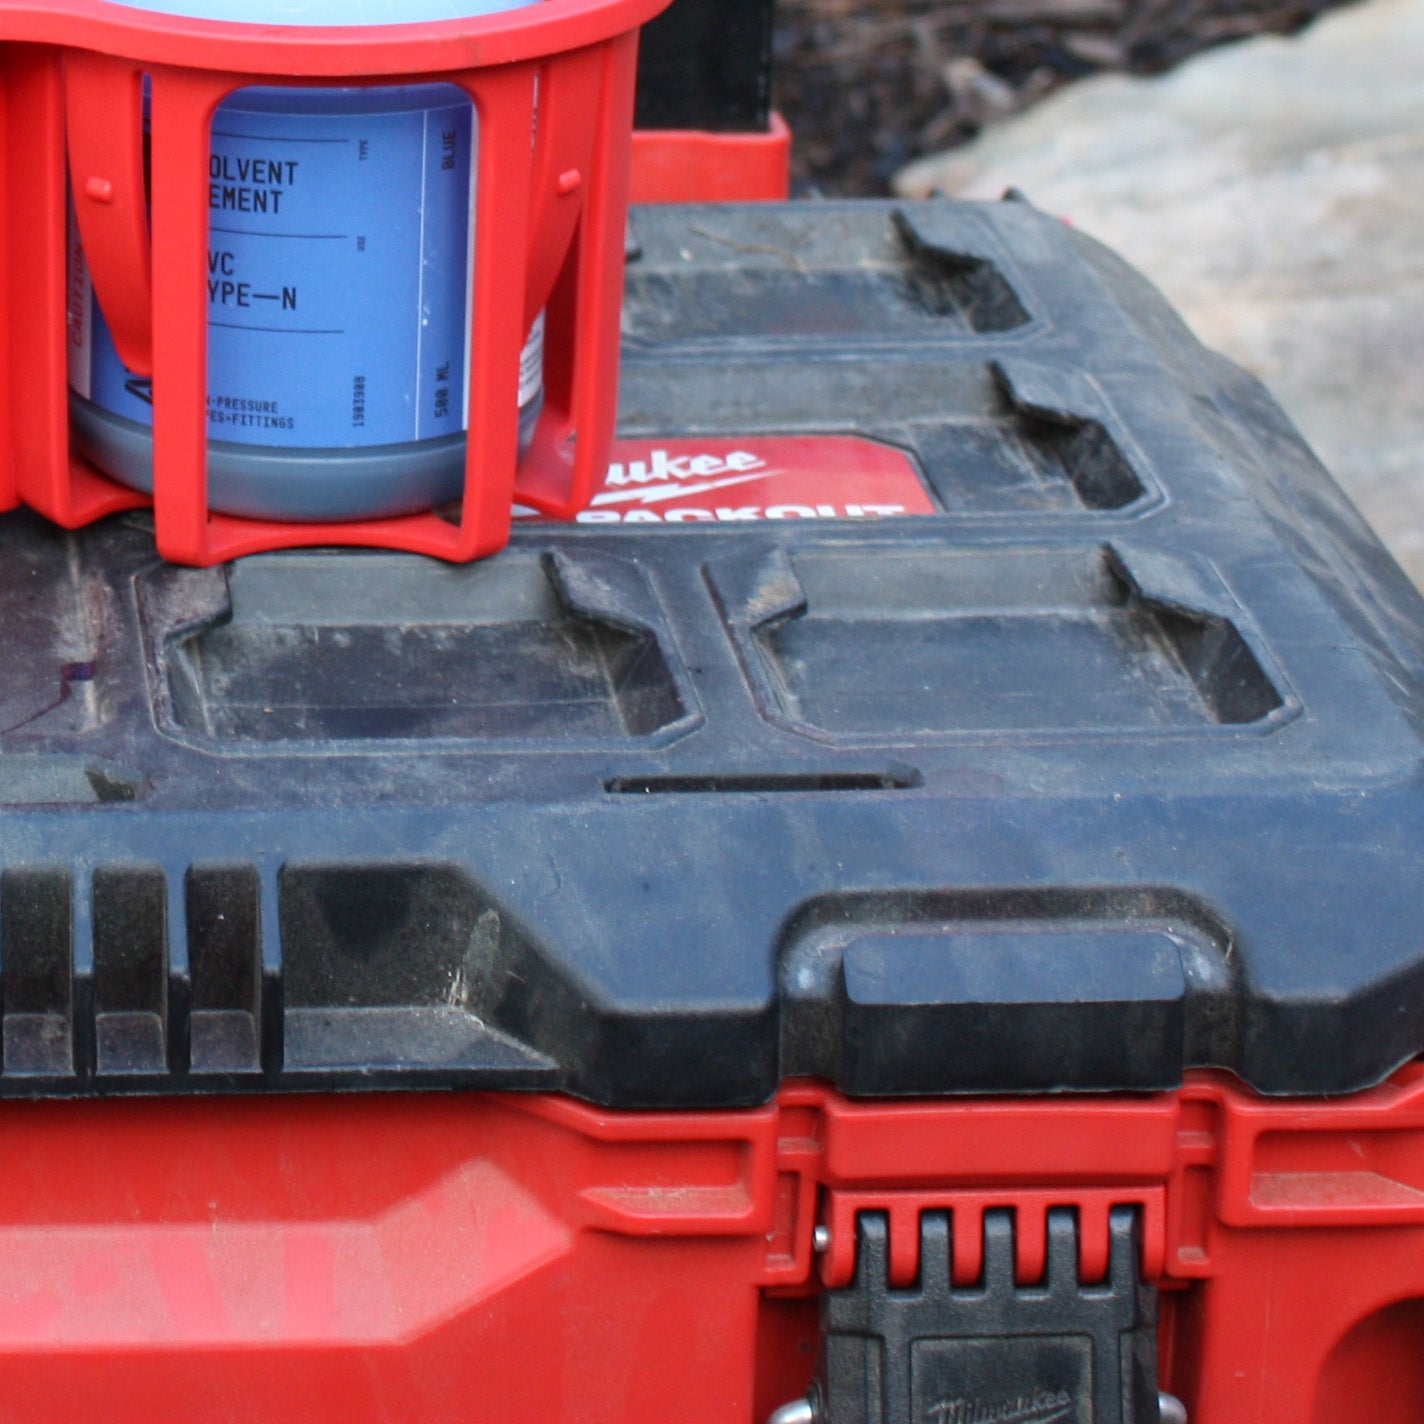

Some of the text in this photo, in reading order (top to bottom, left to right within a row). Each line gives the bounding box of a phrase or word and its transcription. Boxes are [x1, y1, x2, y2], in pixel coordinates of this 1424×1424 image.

[358, 138, 368, 162] TYPE
[442, 129, 457, 171] BLUE
[209, 154, 298, 186] OLVENT
[209, 184, 283, 214] EMENT
[208, 251, 235, 276] VC
[435, 361, 450, 419] 500 ML
[605, 449, 767, 486] ukee
